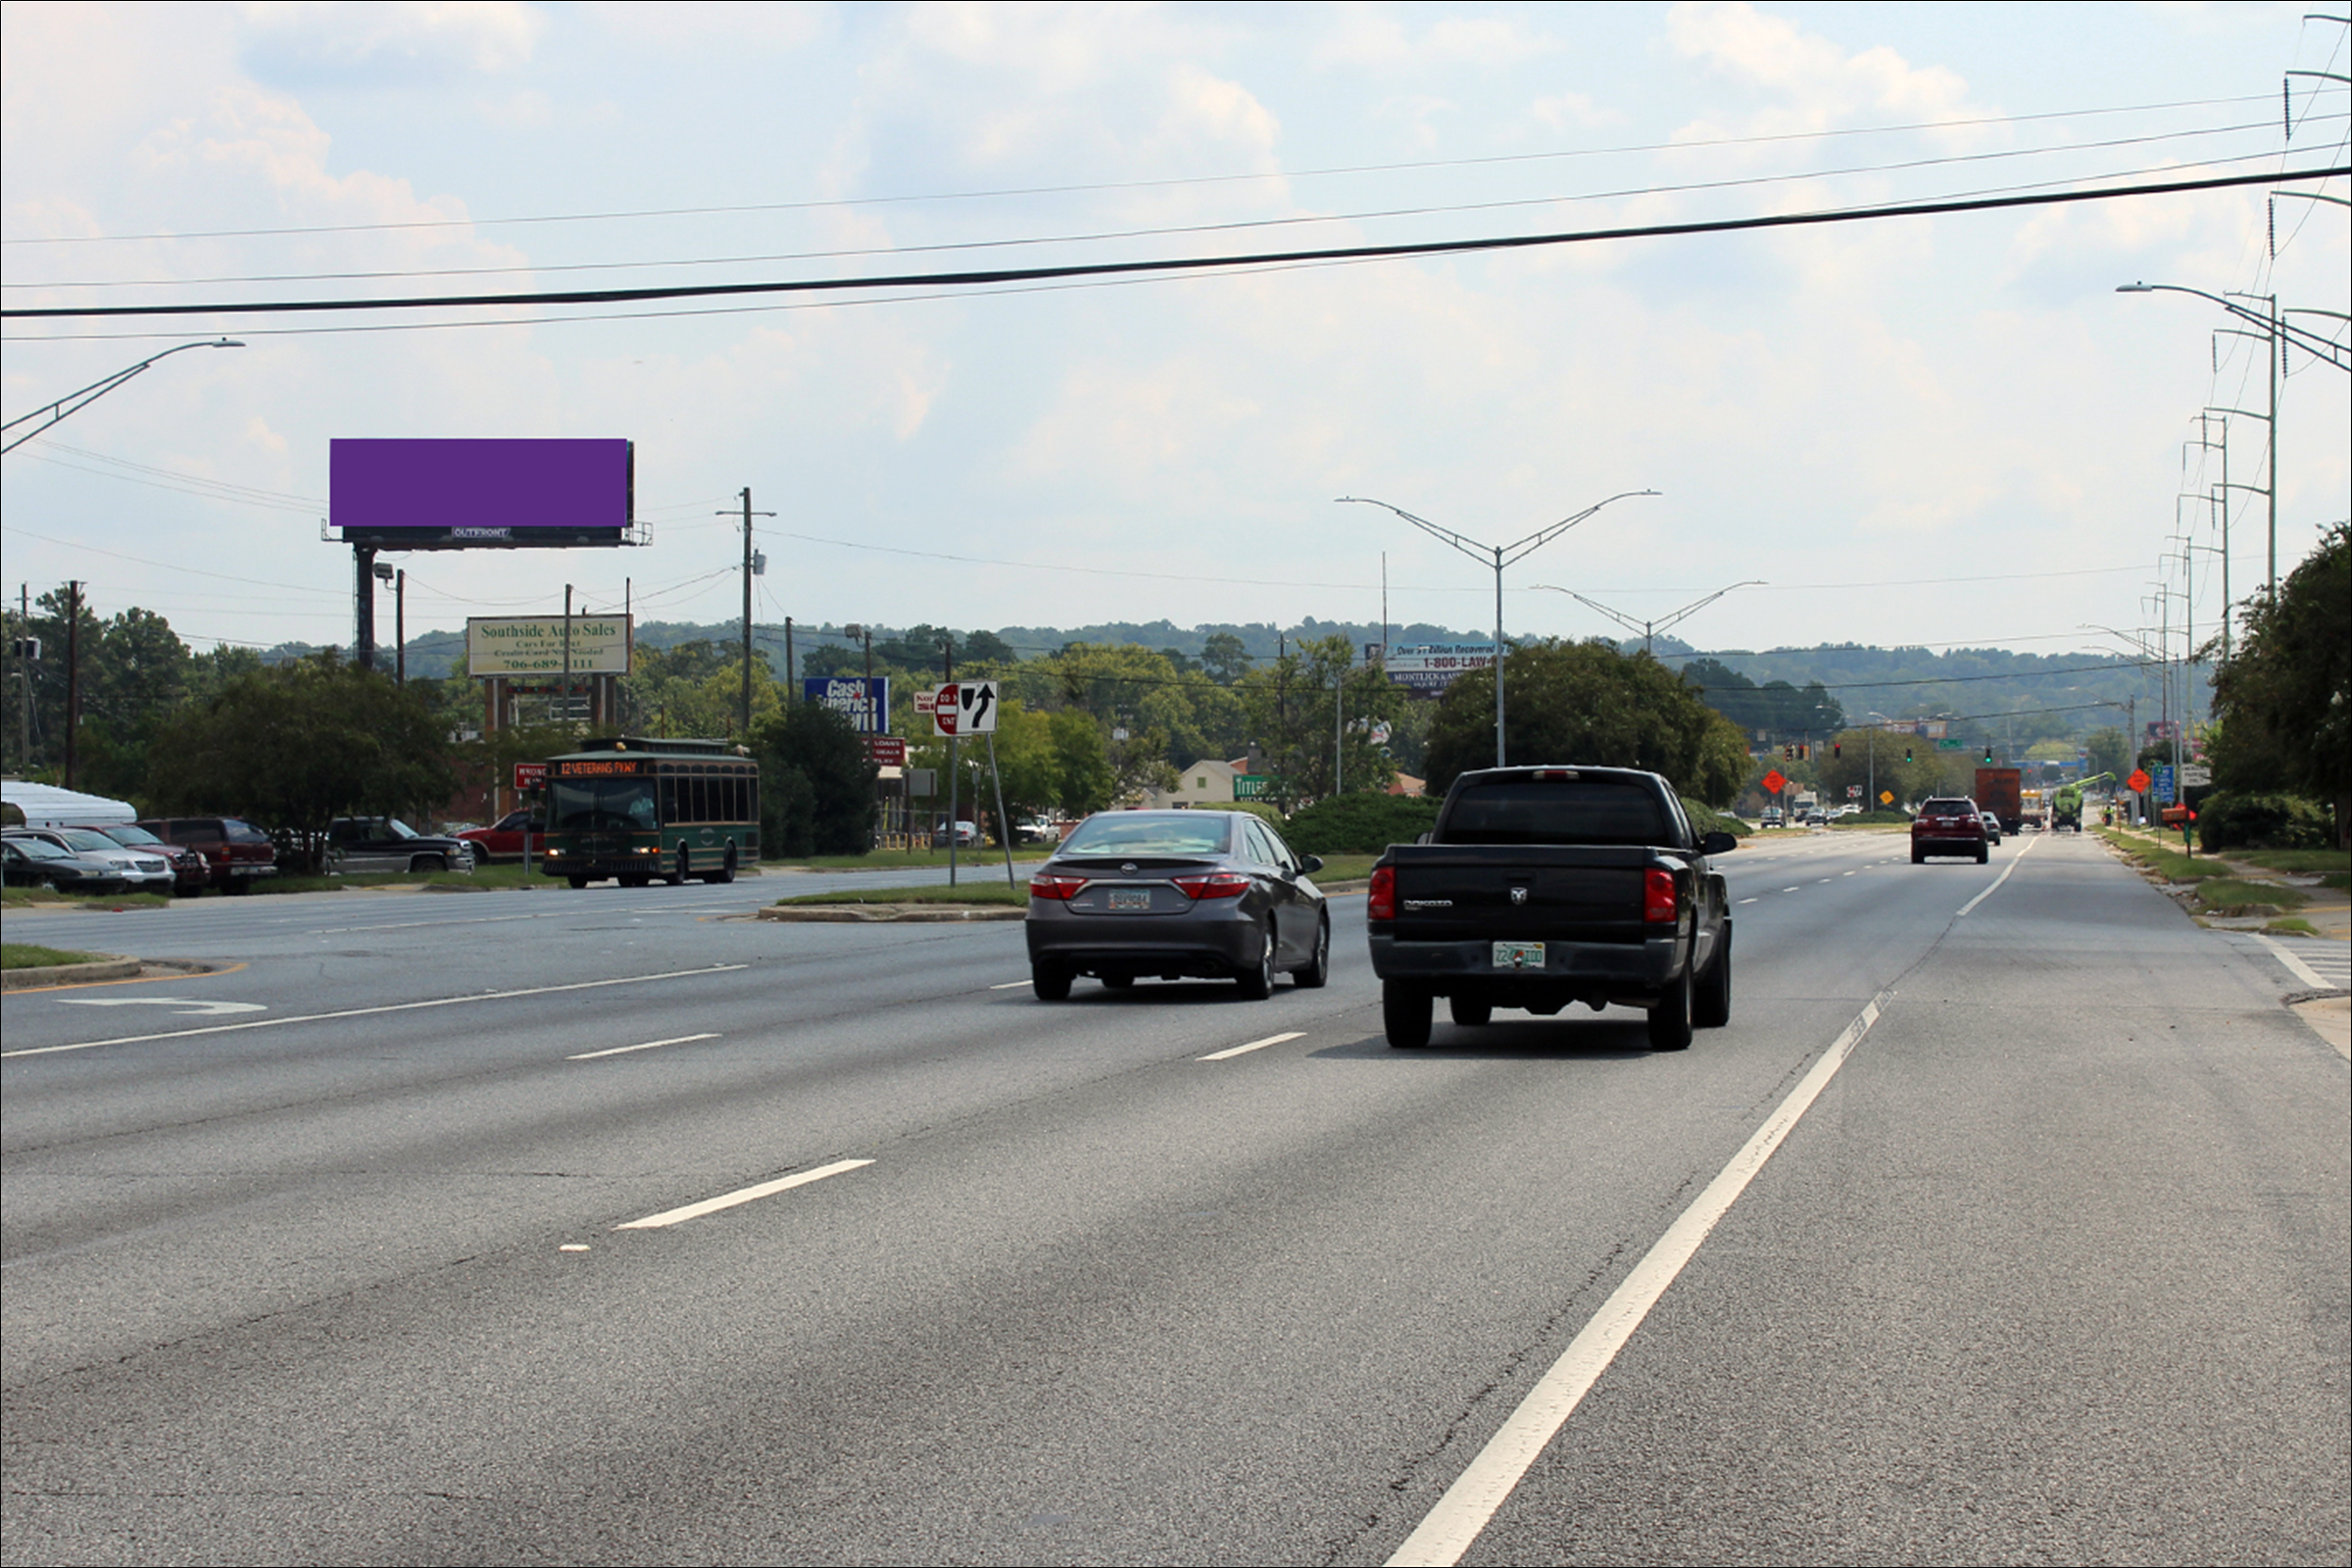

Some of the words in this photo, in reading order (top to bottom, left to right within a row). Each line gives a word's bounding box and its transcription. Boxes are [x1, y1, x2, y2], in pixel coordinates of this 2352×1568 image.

[454, 527, 508, 537] OUTFRONT
[480, 624, 545, 638] Southside
[549, 624, 580, 637] Auo
[582, 623, 616, 636] Sales
[1455, 645, 1495, 655] Recovered
[503, 659, 593, 669] 706-689-111
[826, 679, 866, 698] Cash
[940, 694, 950, 703] DO
[942, 716, 956, 725] ENT
[562, 761, 571, 774] 12
[572, 761, 613, 774] VETERANS
